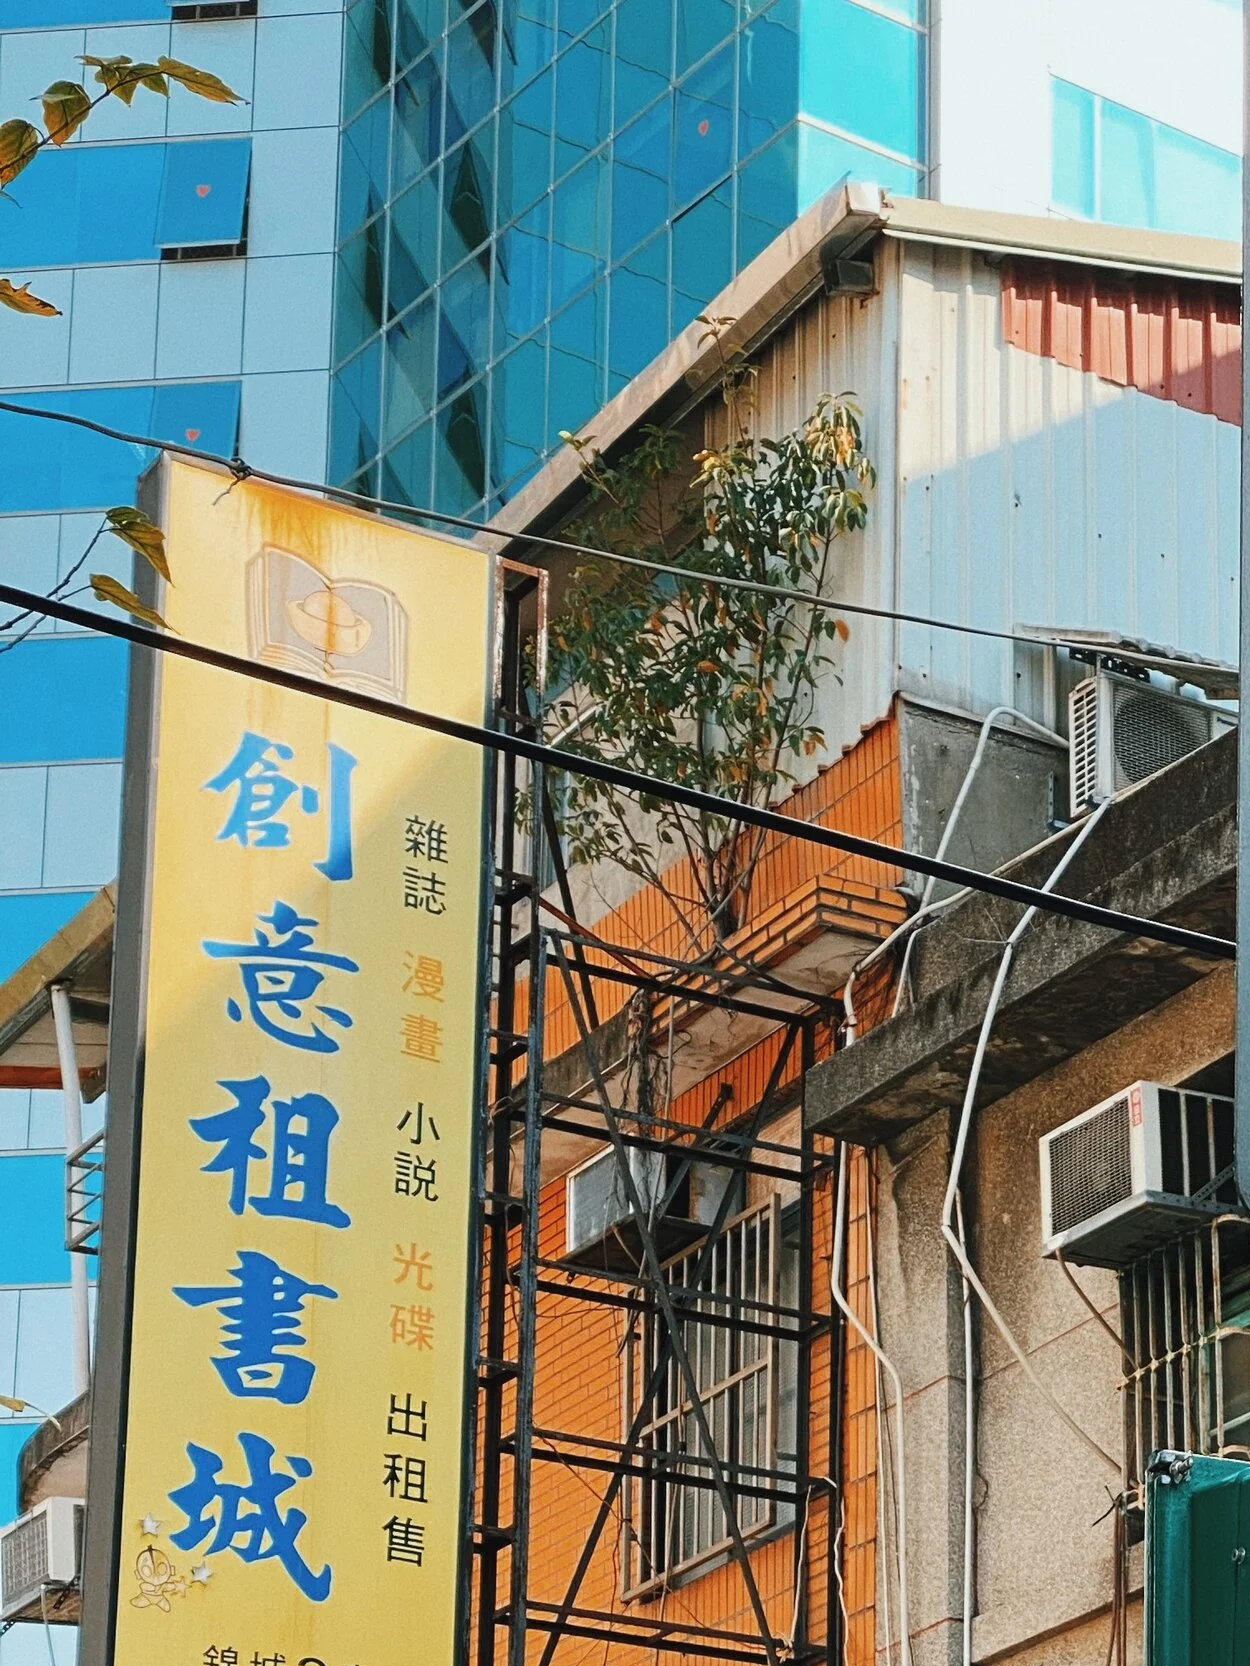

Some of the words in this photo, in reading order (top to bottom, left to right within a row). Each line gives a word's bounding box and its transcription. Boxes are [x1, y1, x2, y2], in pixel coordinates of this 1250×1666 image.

[402, 814, 449, 916] 雜誌
[399, 950, 446, 1064] 漫畫
[167, 730, 360, 1602] 創意租書城
[389, 1241, 436, 1352] 光碟
[382, 1392, 429, 1567] 出租售
